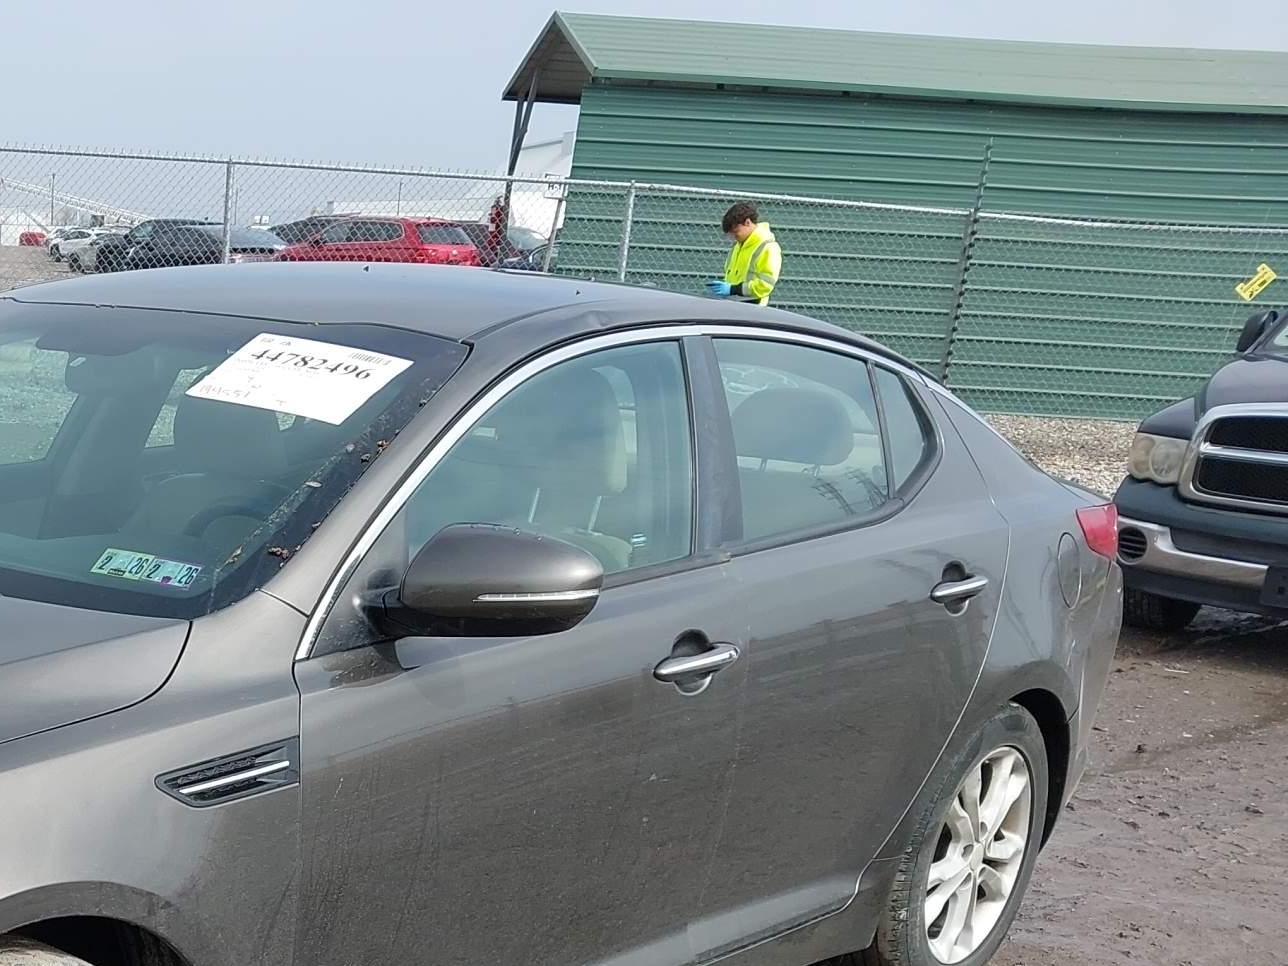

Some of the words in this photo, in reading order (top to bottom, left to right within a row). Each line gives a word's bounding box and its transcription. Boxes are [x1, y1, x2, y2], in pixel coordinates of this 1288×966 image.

[250, 348, 371, 380] 44782496
[98, 555, 112, 571] 2
[128, 557, 150, 575] 26
[146, 563, 161, 579] 2
[178, 566, 199, 585] 26
